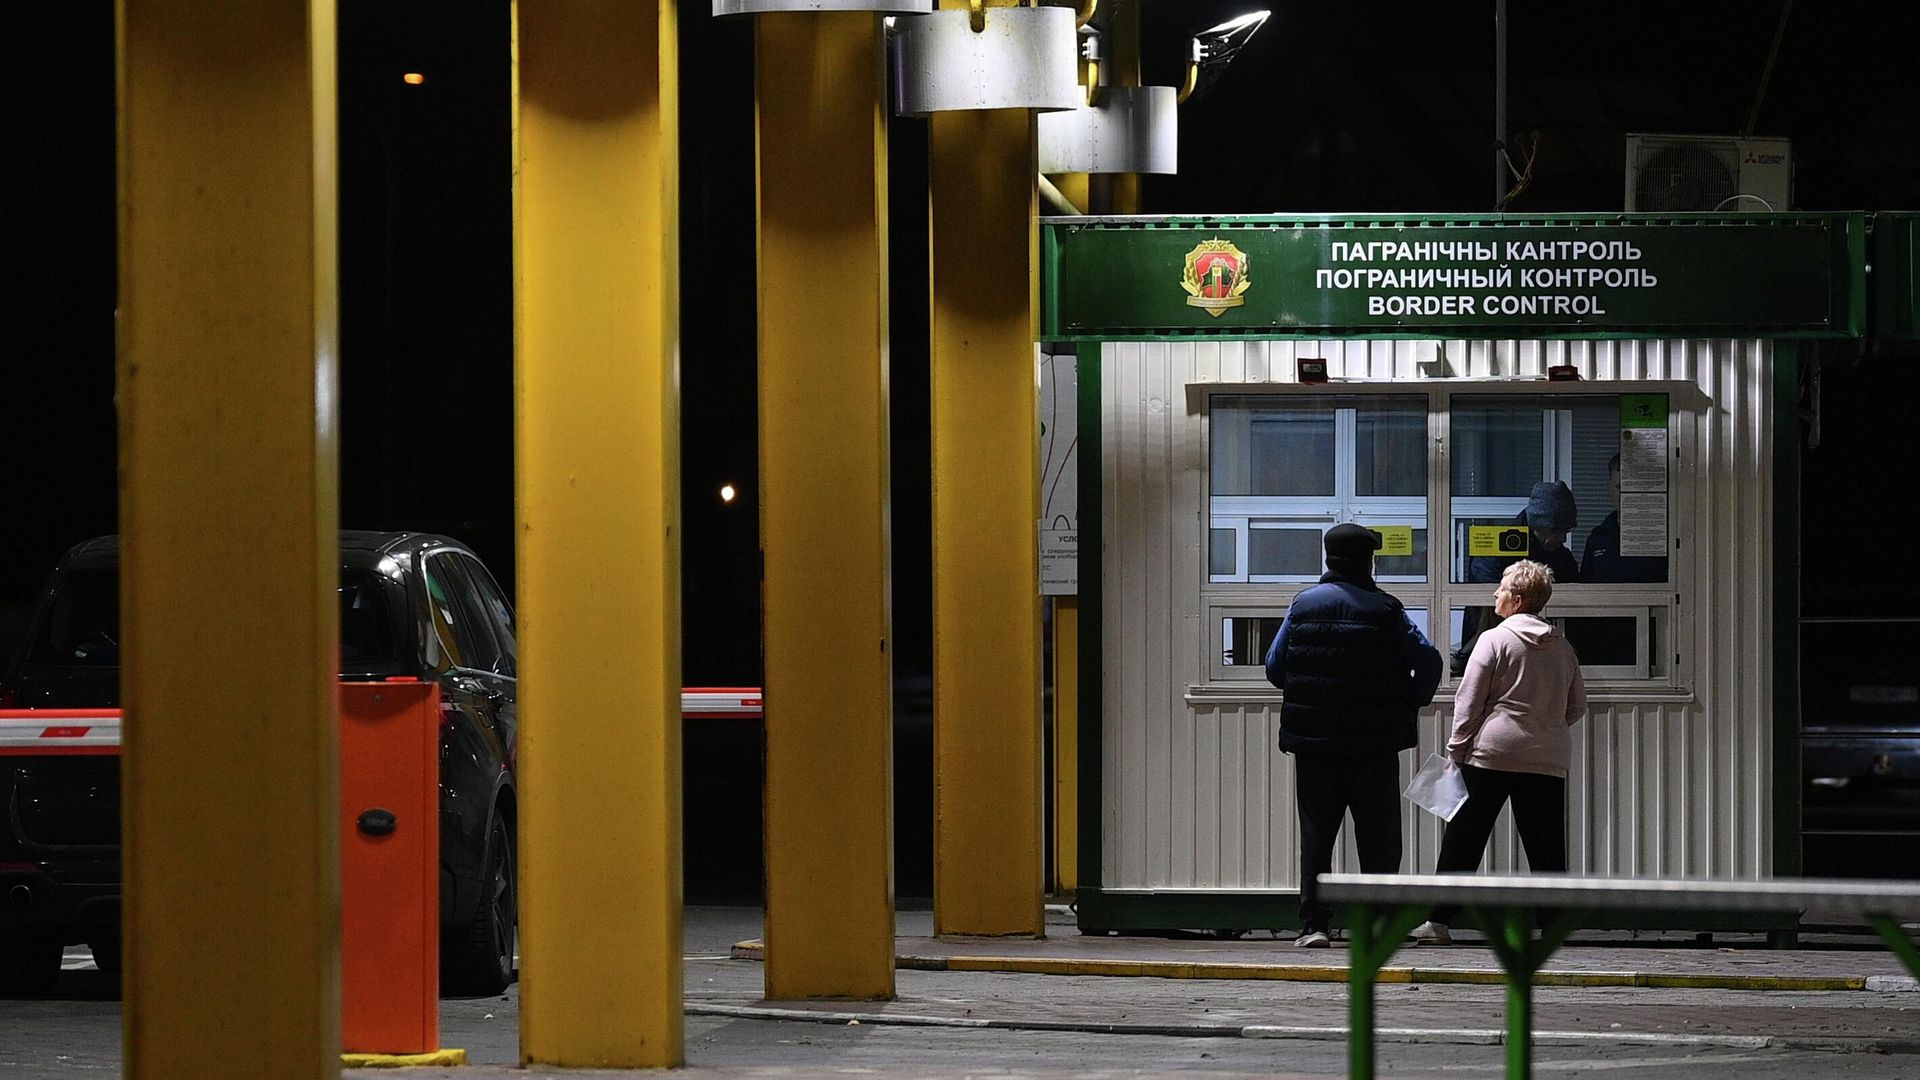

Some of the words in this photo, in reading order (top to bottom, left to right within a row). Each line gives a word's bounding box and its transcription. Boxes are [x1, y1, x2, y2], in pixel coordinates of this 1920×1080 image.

[1331, 241, 1497, 262] ПАГРАНІЧНЫ
[1506, 241, 1642, 261] КАНТРОЛЬ
[1316, 264, 1512, 289] ПОГРАНИЧНЫЙ
[1520, 268, 1658, 288] КОНТРОЛЬ
[1368, 296, 1476, 315] BORDER
[1482, 295, 1606, 315] CONTROL
